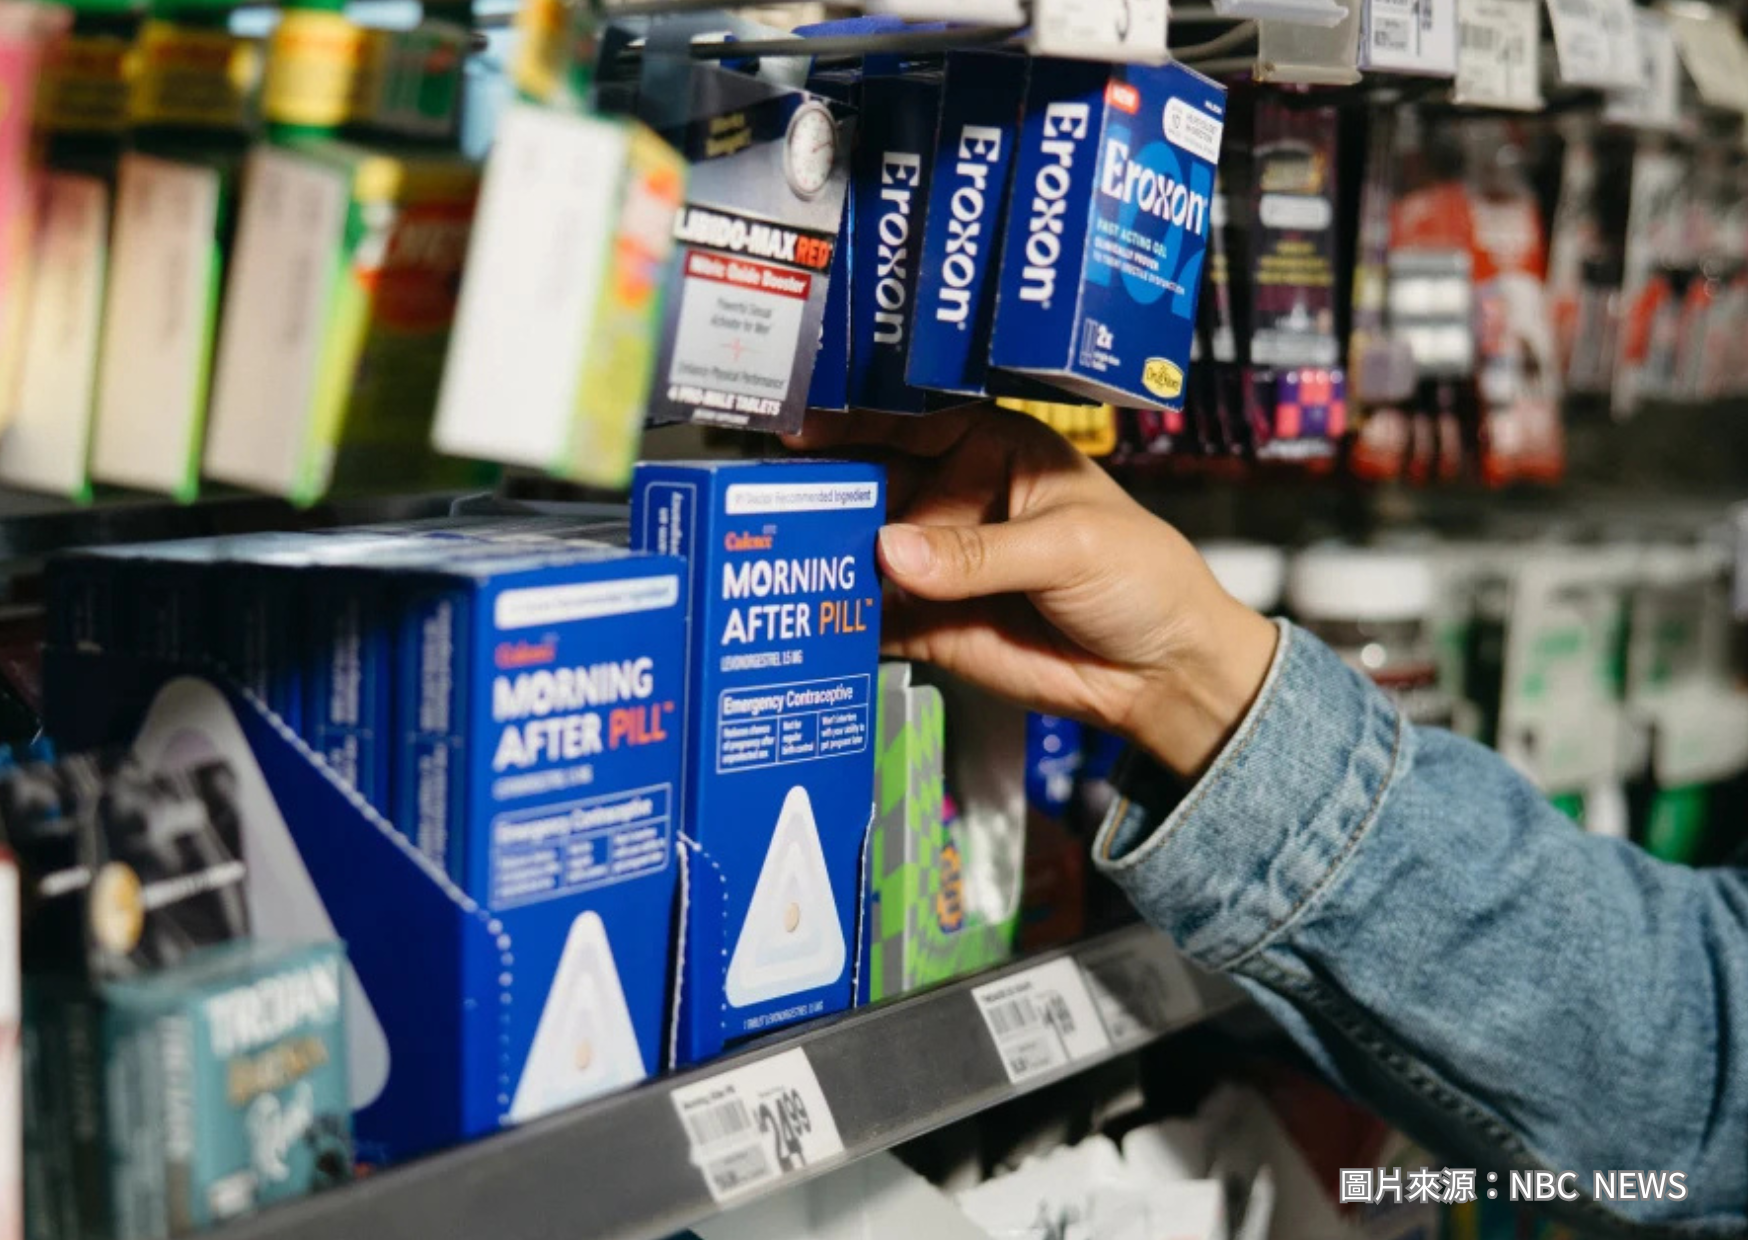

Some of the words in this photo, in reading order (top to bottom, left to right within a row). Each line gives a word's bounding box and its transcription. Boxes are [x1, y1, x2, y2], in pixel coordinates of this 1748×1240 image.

[1019, 102, 1090, 302] Eroxon
[1100, 138, 1208, 236] Eroxon
[874, 151, 921, 345] Eroxon
[936, 124, 1002, 323] Eroxon
[722, 555, 855, 600] MORNING
[721, 603, 811, 646] AFTER
[492, 656, 653, 723] MORNING
[723, 696, 783, 715] Emergency
[786, 683, 853, 708] Contraceptive
[492, 712, 603, 772] AFTER
